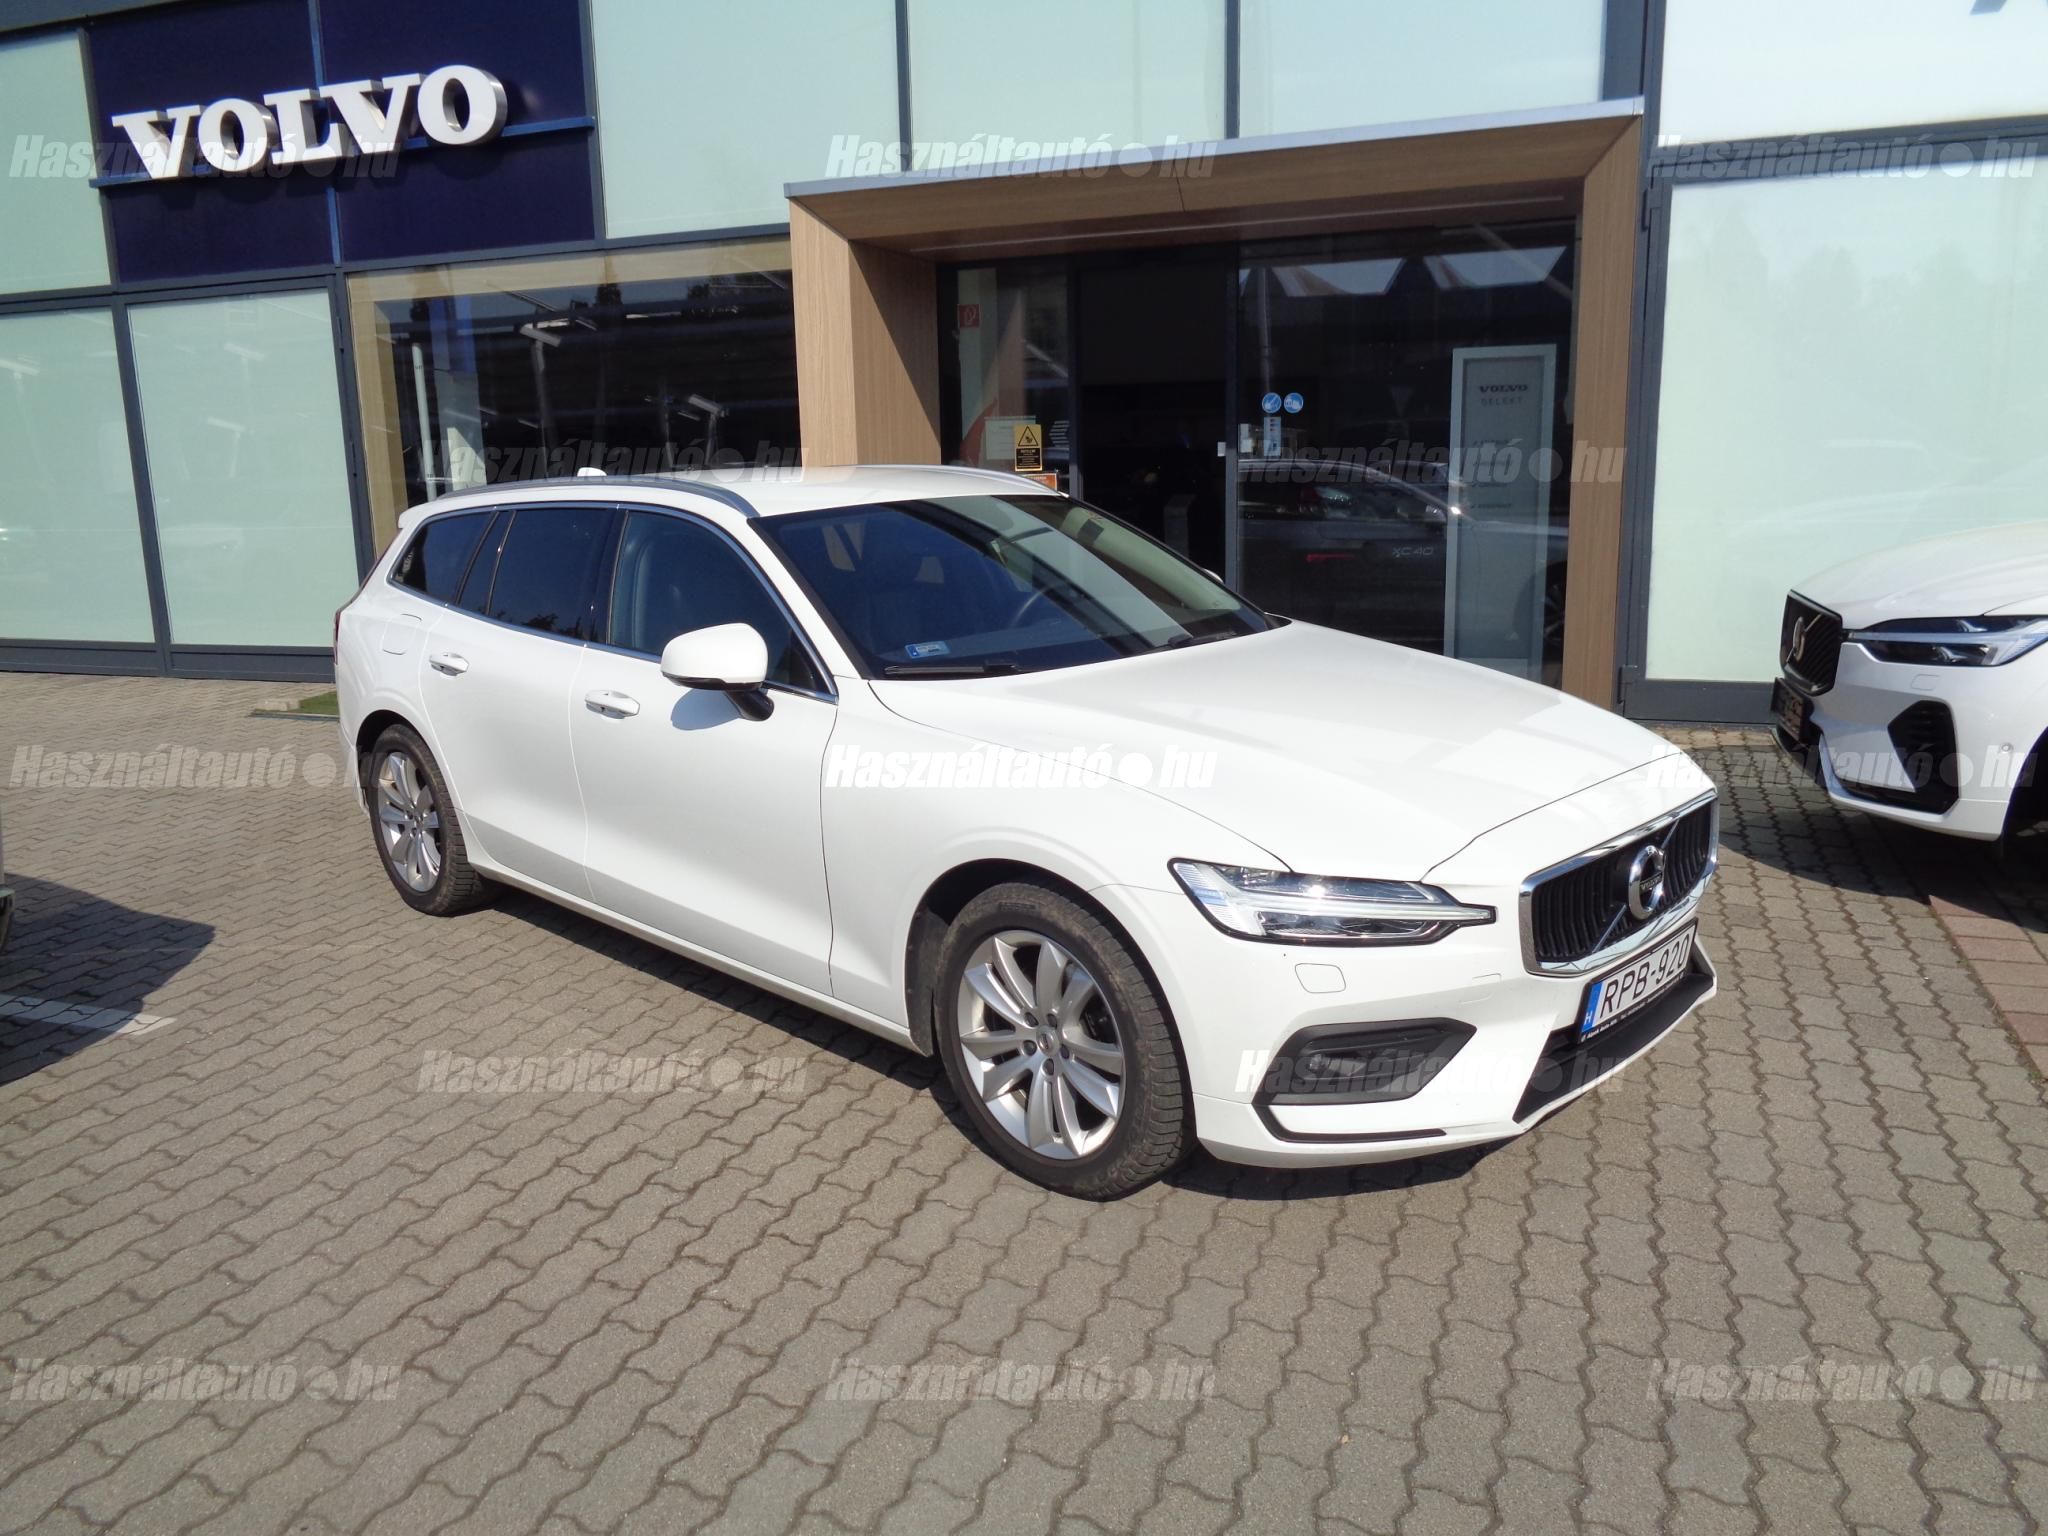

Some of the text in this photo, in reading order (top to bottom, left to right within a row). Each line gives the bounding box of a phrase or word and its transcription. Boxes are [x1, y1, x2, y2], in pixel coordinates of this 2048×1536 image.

[112, 65, 507, 179] VOLVO
[1479, 384, 1528, 393] VOLVO
[1584, 934, 1690, 1025] H RPB-920
